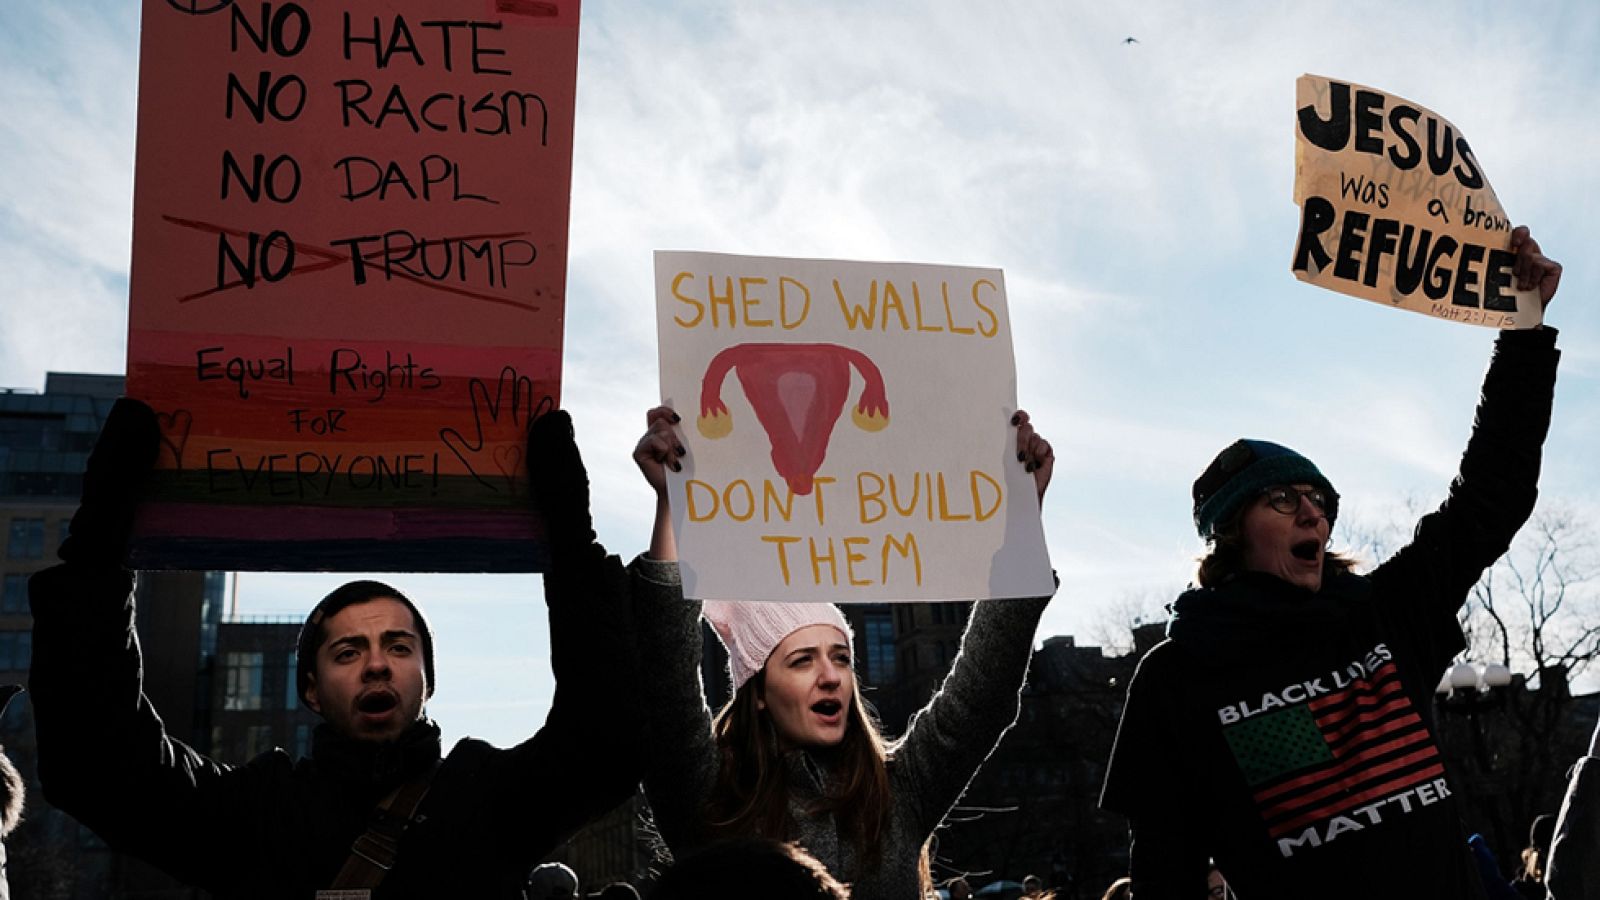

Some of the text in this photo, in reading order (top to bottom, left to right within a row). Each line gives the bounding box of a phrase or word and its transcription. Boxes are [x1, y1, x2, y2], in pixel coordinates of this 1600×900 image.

[231, 1, 512, 75] NO HATE
[225, 71, 547, 146] NO RACISM
[1297, 81, 1483, 189] JESUS
[221, 149, 500, 204] NO DAPL
[1427, 198, 1449, 224] a
[217, 230, 536, 290] NO TRUMP
[1292, 196, 1518, 313] REFUGEE
[671, 271, 999, 338] SHED WALLS
[196, 347, 442, 402] Equal Rights
[206, 447, 440, 496] EVERYONE!
[856, 470, 1003, 524] BUILD
[761, 532, 922, 587] THEM
[1217, 677, 1330, 725] BLACK
[1277, 777, 1452, 858] MATTER
